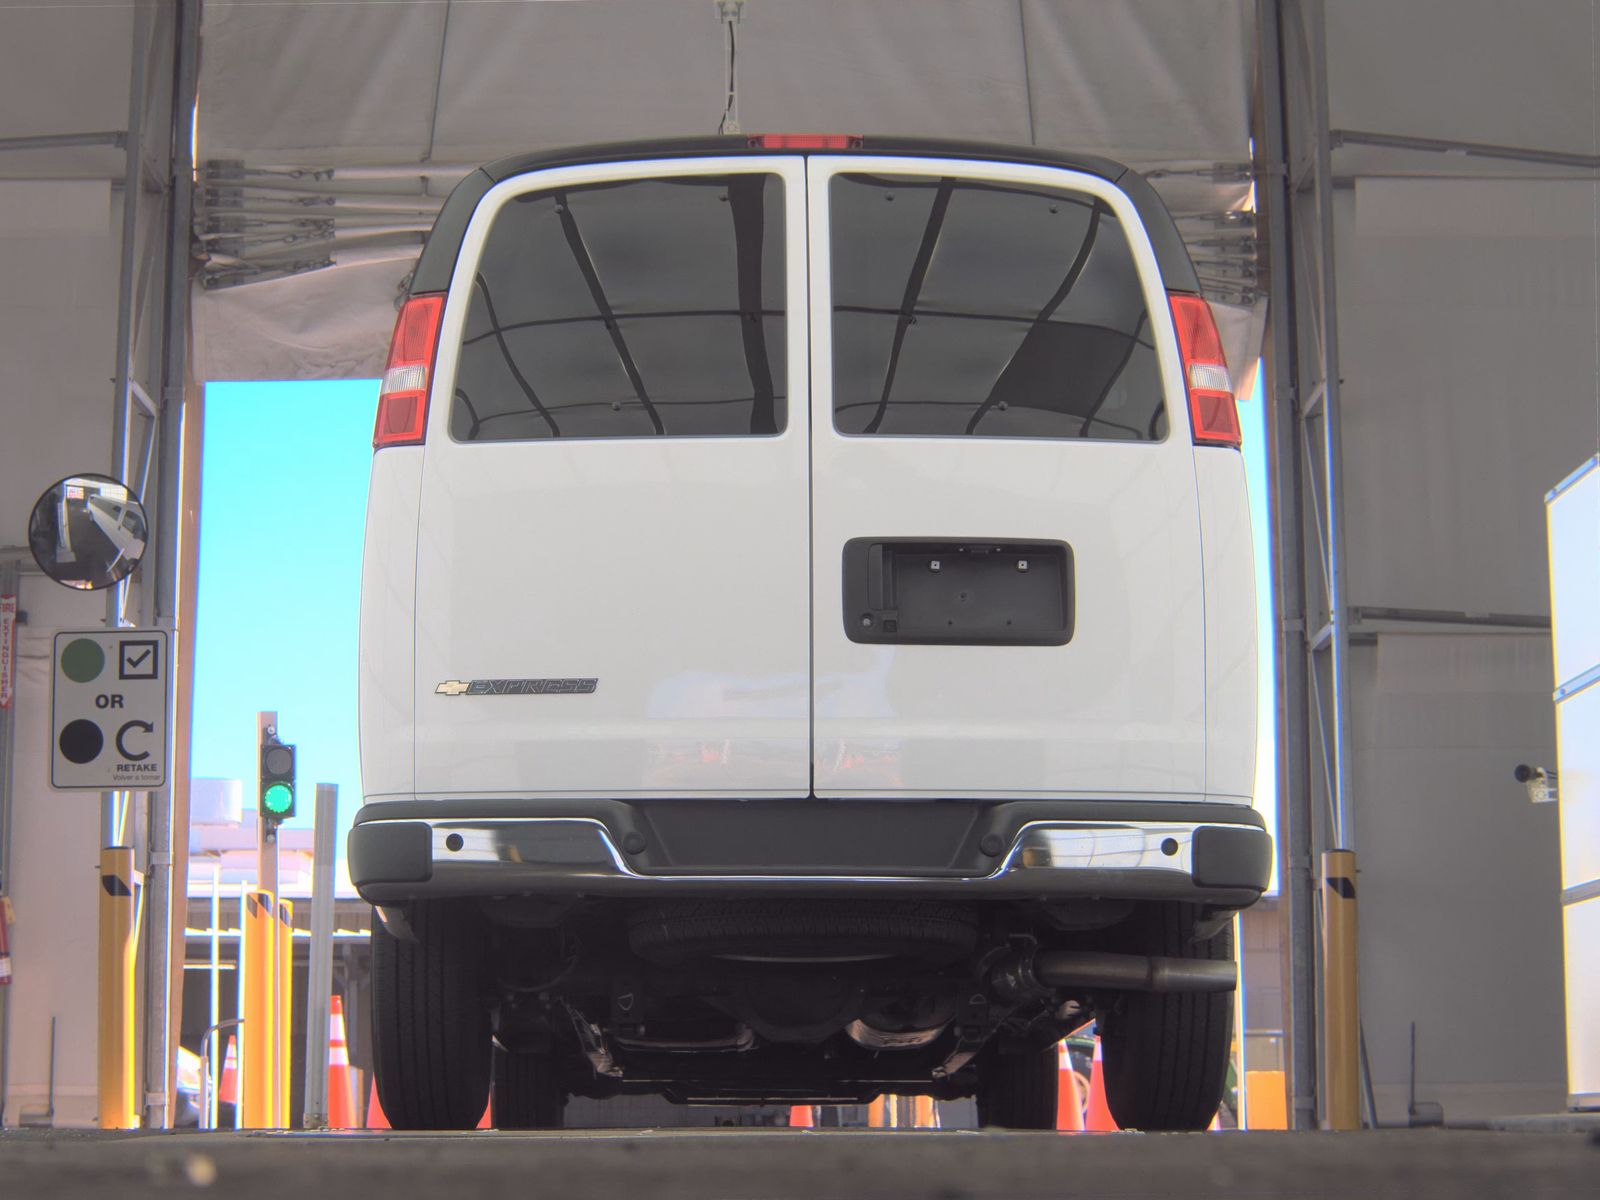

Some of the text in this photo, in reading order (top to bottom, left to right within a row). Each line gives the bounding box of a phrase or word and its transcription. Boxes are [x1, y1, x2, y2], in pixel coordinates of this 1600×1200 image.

[467, 679, 598, 695] EXPRESS
[95, 694, 124, 709] OR
[117, 763, 158, 772] RETAKE
